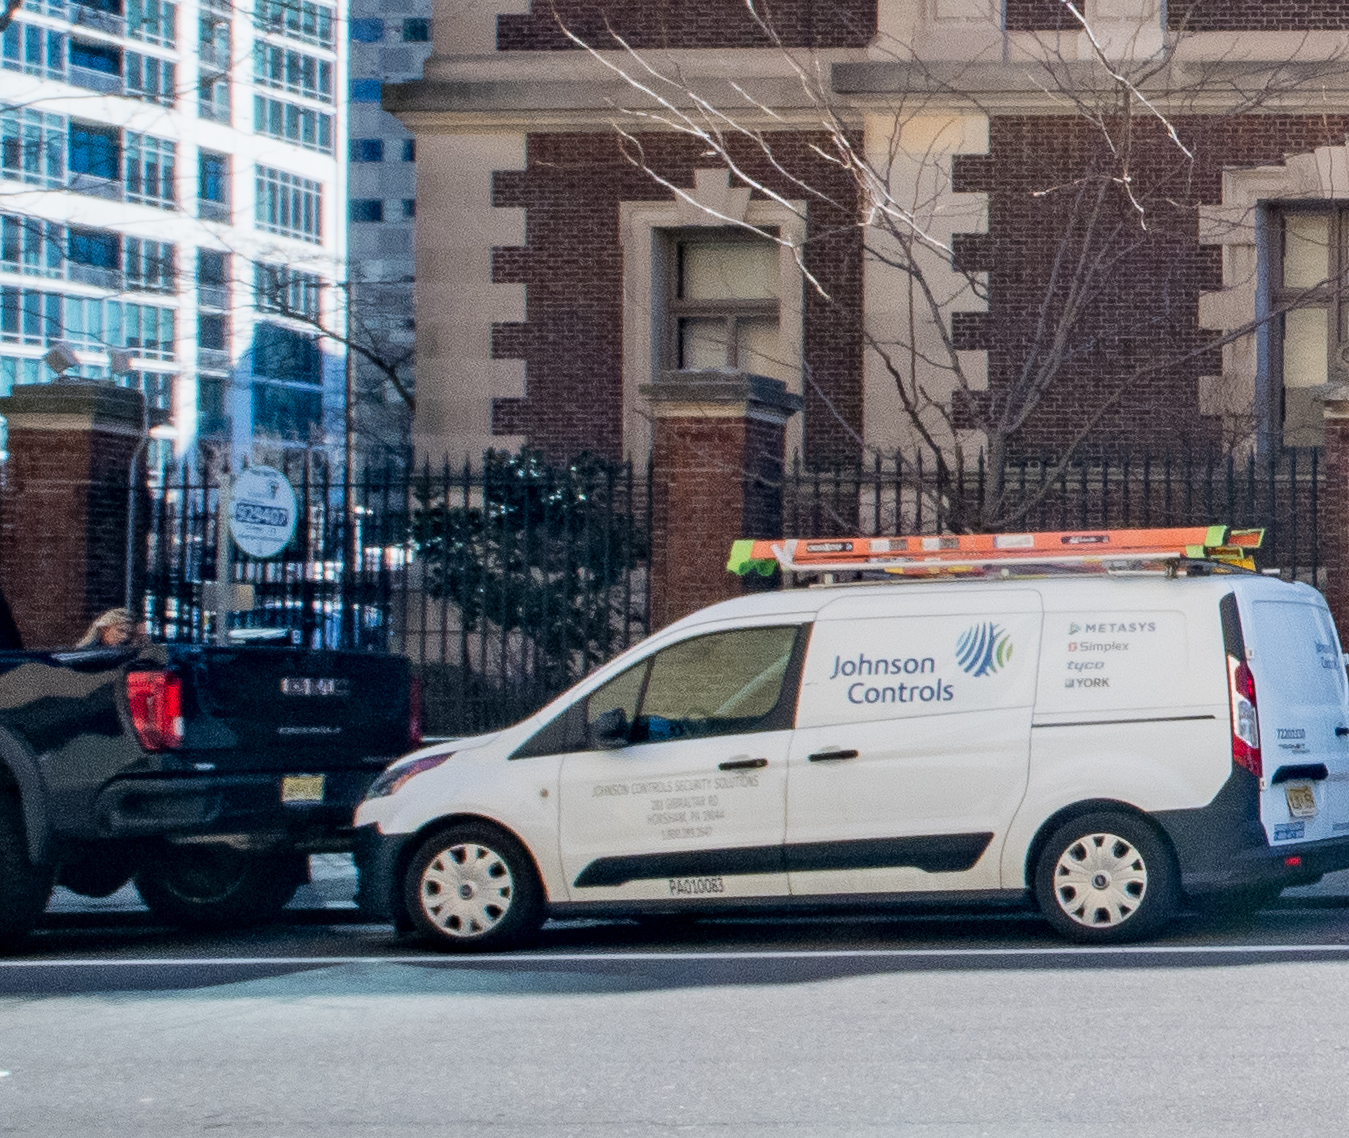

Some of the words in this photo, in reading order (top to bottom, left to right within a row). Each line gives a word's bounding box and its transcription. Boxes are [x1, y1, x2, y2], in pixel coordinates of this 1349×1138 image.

[1085, 622, 1157, 633] METASYS
[1079, 641, 1130, 653] Simplex
[830, 653, 935, 679] Johnson
[1067, 661, 1105, 672] tyco
[1076, 678, 1110, 688] YORK
[847, 678, 954, 704] Controls
[592, 784, 629, 797] JOHNSON
[631, 781, 673, 795] CONTROLS
[675, 778, 712, 792] SECURITY
[714, 775, 759, 790] SOLUTIONS
